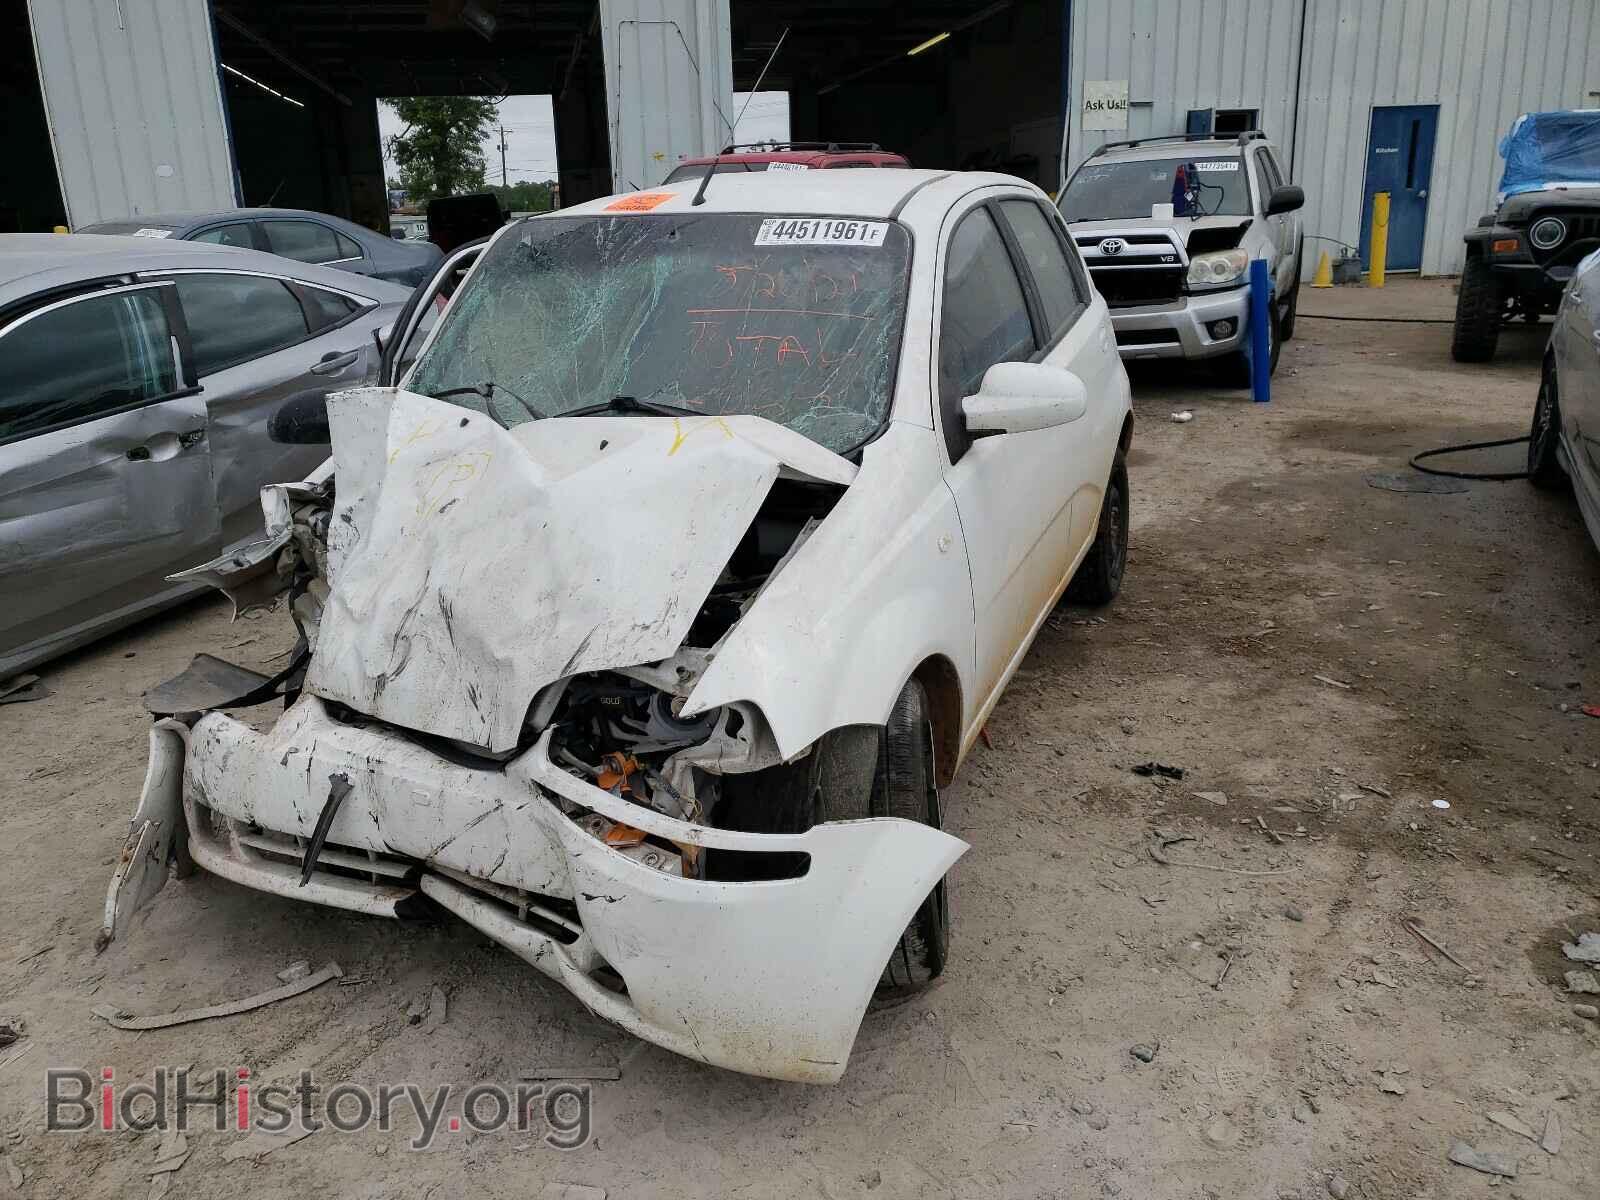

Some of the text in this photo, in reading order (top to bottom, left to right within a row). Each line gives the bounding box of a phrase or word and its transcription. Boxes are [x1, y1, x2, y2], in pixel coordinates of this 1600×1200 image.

[1085, 99, 1127, 110] Ask Us!!
[772, 220, 869, 241] 44511961
[870, 229, 880, 239] F
